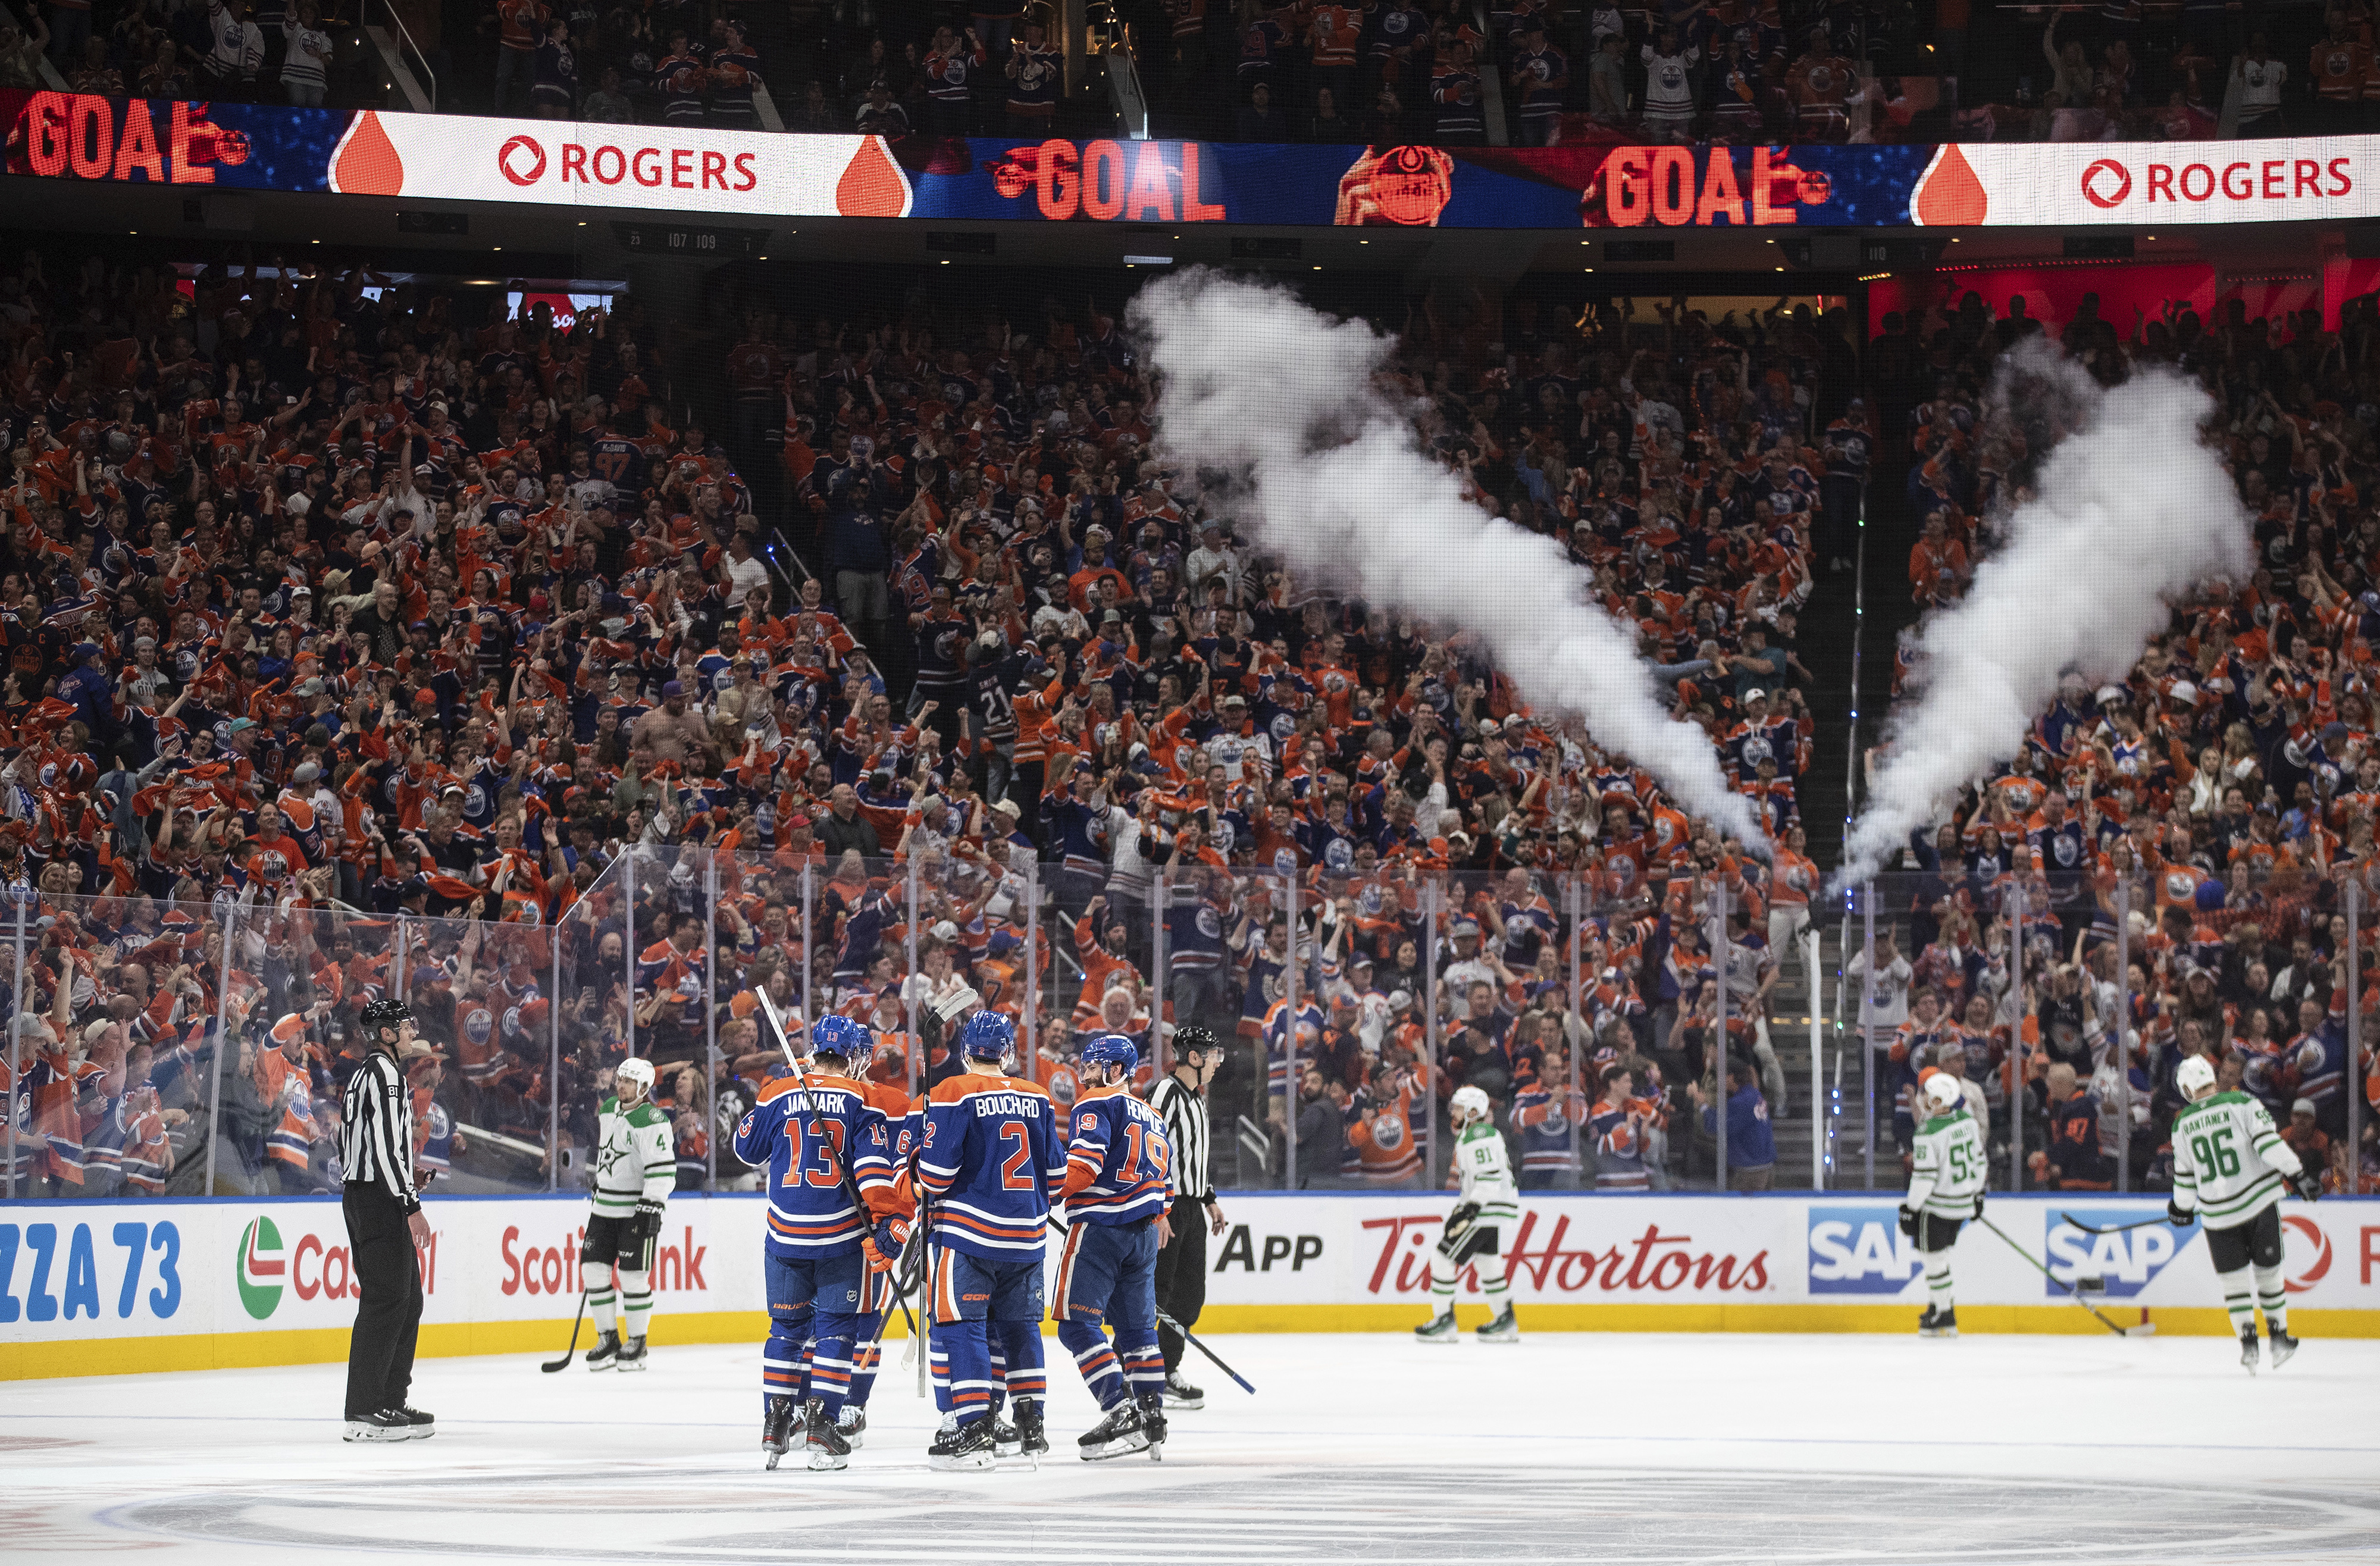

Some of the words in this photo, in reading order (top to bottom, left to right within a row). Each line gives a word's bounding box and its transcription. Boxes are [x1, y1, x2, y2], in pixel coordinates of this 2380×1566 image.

[27, 91, 215, 184] GOAL
[562, 143, 756, 192] ROGERS
[1037, 139, 1226, 221] GOAL
[2148, 158, 2351, 202] ROGERS
[1606, 146, 1796, 226] GOAL
[669, 234, 687, 248] 107
[697, 235, 716, 250] 109
[596, 453, 631, 481] 97
[39, 633, 46, 644] C
[13, 655, 40, 668] OILERS
[58, 678, 81, 693] Oilers
[981, 685, 1012, 726] 21
[827, 1032, 838, 1042] 13
[979, 1047, 985, 1056] 2
[389, 1087, 398, 1097] 81
[784, 1093, 845, 1114] JANMARK
[976, 1097, 1039, 1119] BOUCHARD
[923, 1122, 936, 1148] 2
[1077, 1113, 1098, 1137] 9
[2182, 1110, 2230, 1136] RANTANEN
[626, 1131, 632, 1145] A
[656, 1133, 666, 1151] 4
[894, 1129, 911, 1155] 6
[782, 1117, 845, 1189] 13
[1000, 1121, 1035, 1191] 2
[1116, 1122, 1168, 1184] 19
[1474, 1147, 1493, 1166] 91
[2191, 1127, 2240, 1183] 96
[635, 1204, 663, 1214] CCM
[501, 1225, 707, 1295] Scotink
[1502, 1210, 1768, 1291] Hortons
[2047, 1222, 2175, 1283] SAP
[113, 1220, 181, 1319] 73
[293, 1233, 437, 1301] Casl
[959, 1432, 985, 1452] CCM
